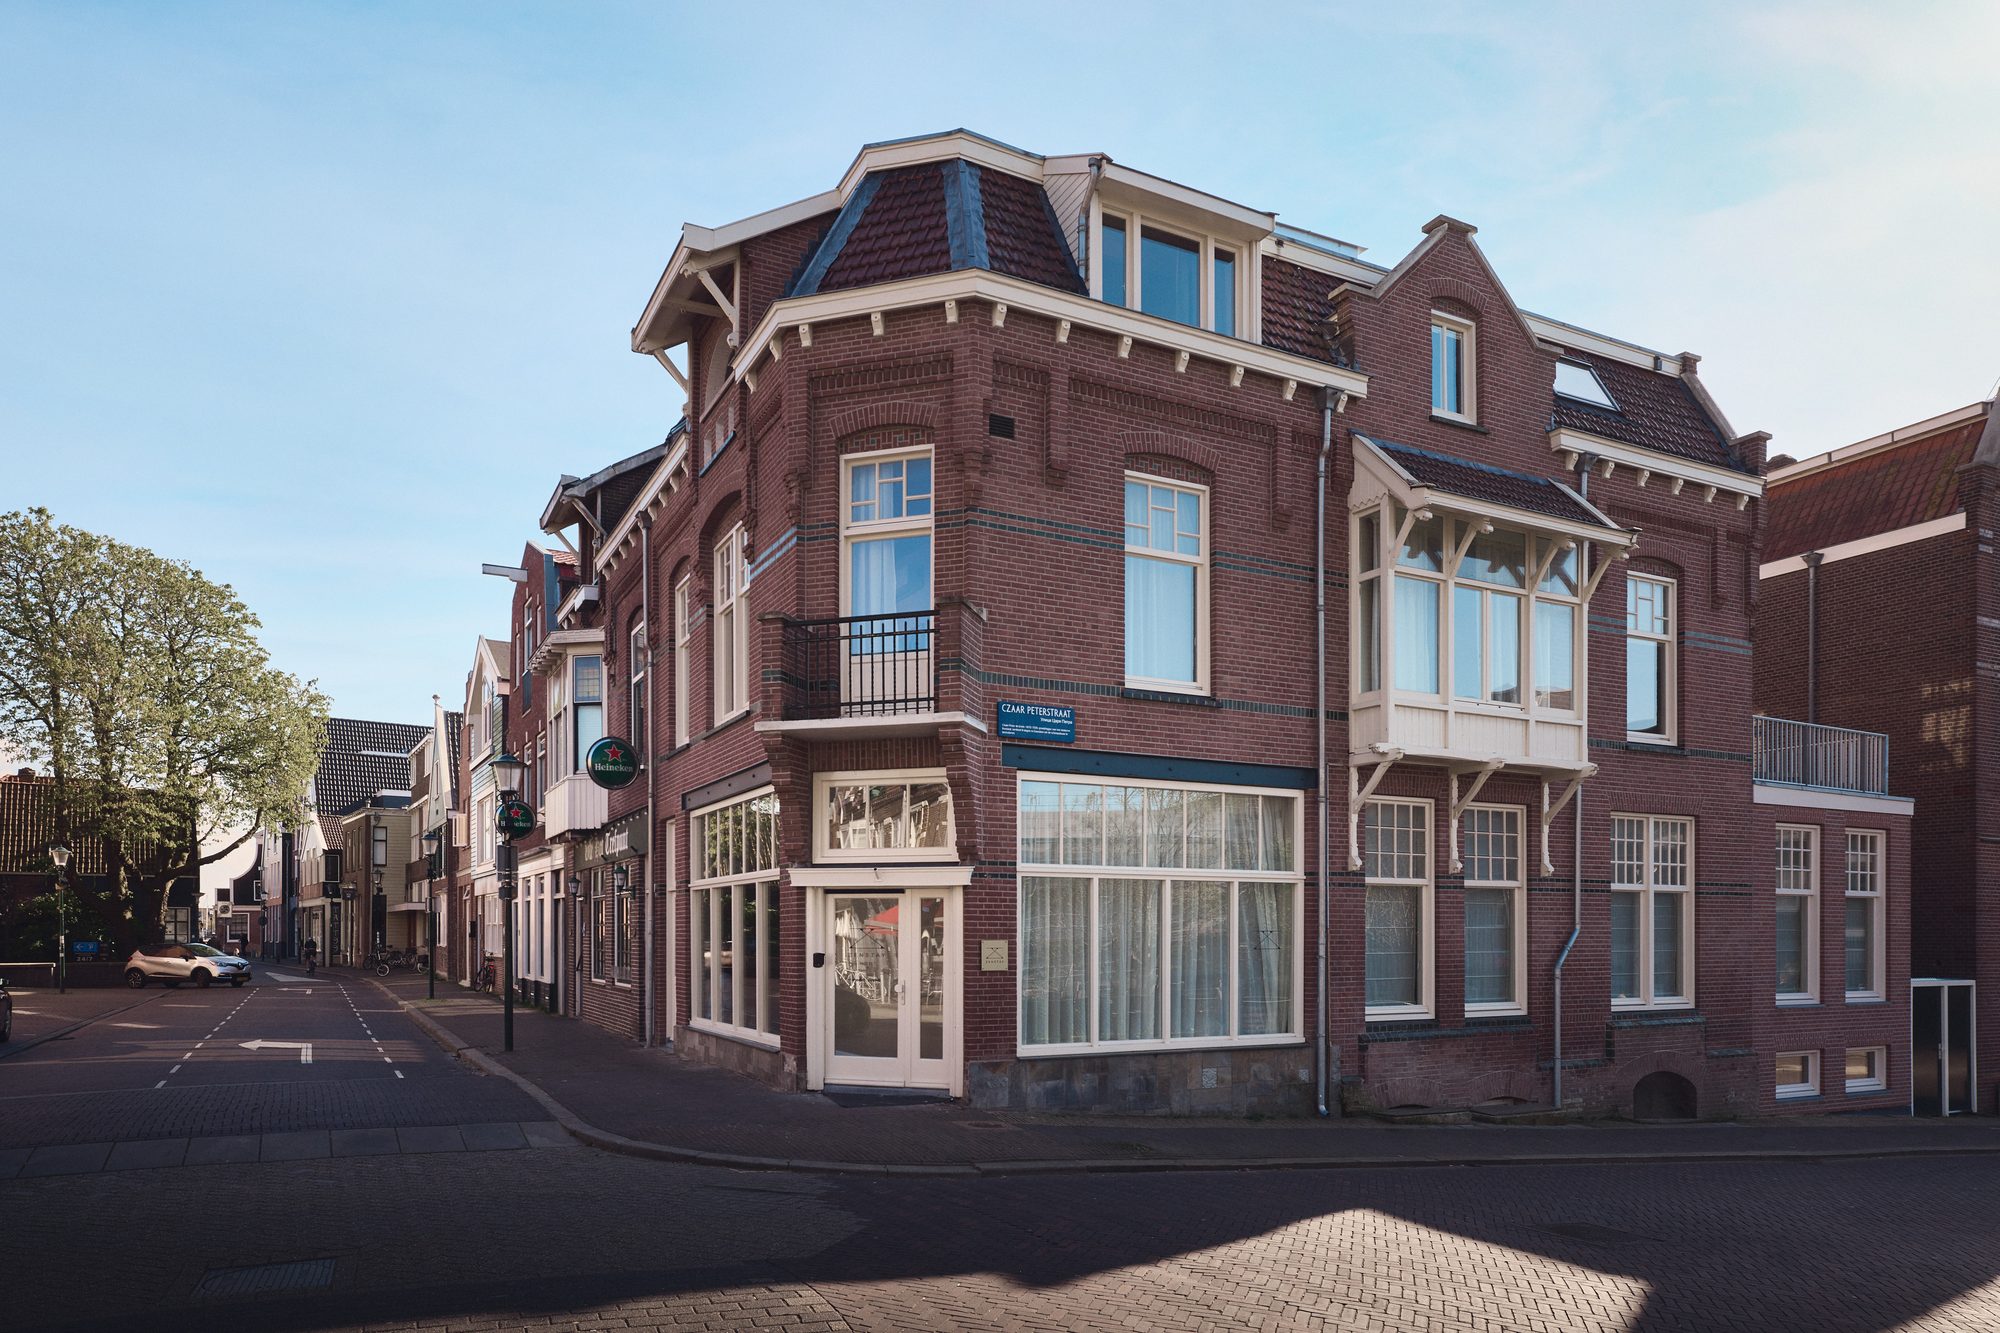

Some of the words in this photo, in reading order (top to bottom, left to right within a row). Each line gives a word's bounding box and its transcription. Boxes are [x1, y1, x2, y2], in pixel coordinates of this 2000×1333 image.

[1001, 704, 1025, 714] CZAAR
[1027, 706, 1071, 718] PETERSTRAAT
[594, 763, 633, 772] Heineken
